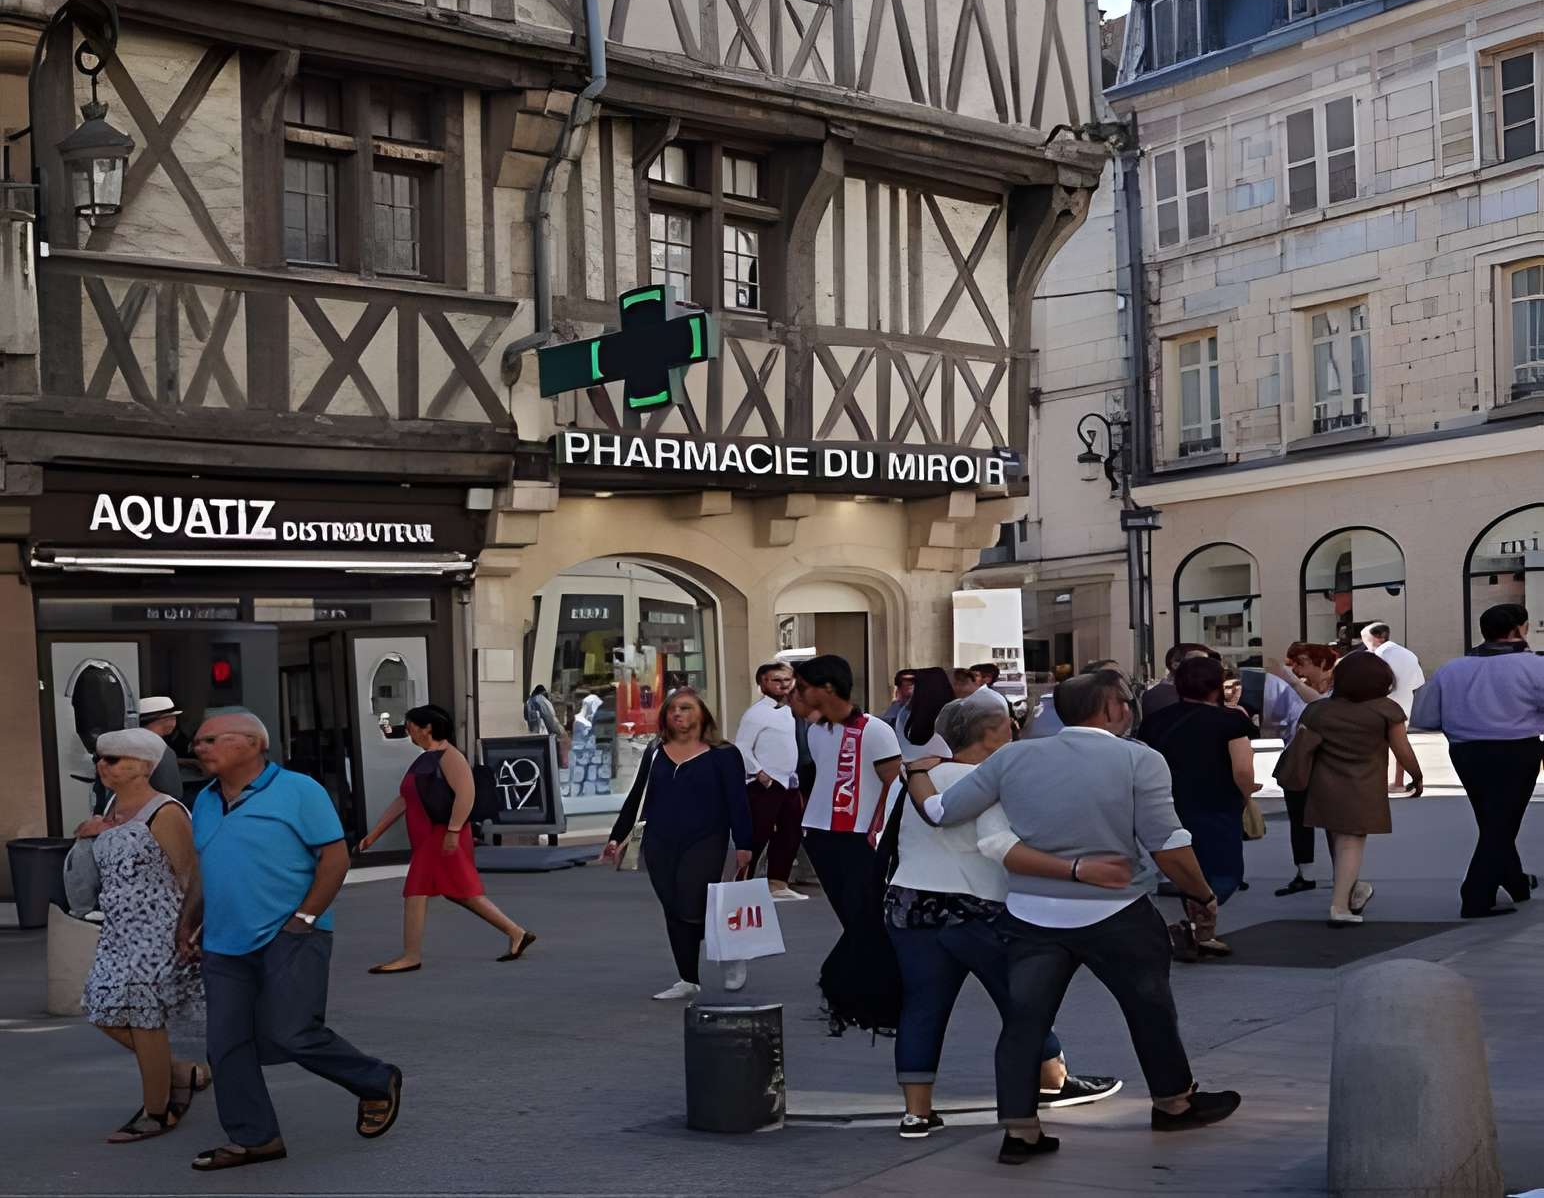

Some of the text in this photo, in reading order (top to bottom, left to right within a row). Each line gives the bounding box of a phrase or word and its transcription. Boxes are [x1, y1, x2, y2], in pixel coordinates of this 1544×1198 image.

[564, 431, 1005, 486] PHARMACIE DU MIROIR
[89, 493, 277, 540] AQUATIZ
